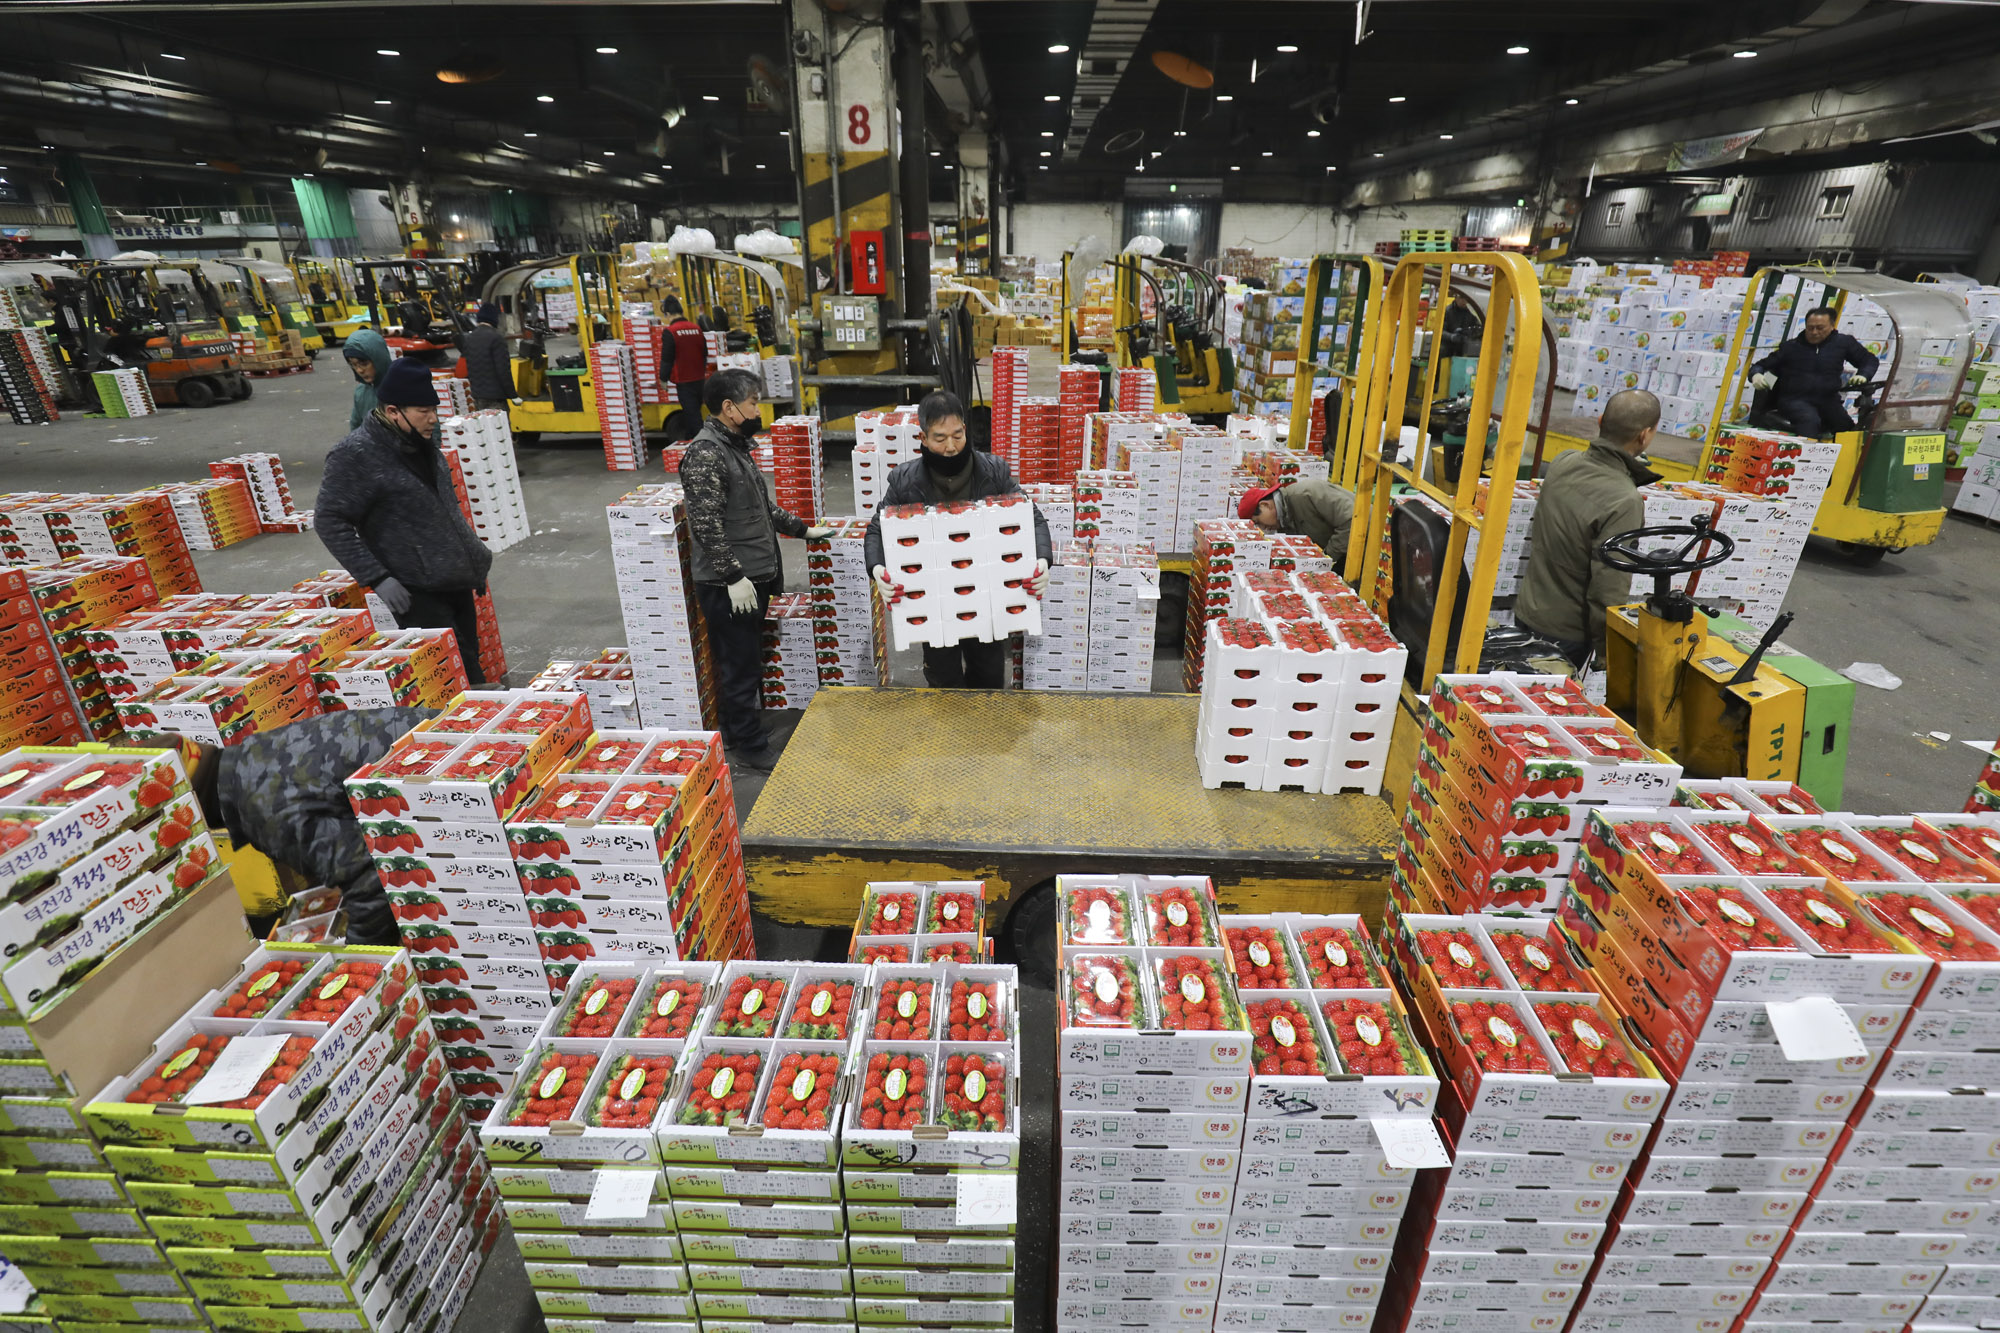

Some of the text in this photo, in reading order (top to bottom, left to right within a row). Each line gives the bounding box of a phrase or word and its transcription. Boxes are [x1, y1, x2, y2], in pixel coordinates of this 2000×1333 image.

[848, 104, 871, 144] 8
[410, 212, 418, 225] 6
[1553, 222, 1566, 234] 12
[203, 344, 233, 354] TOYOTA
[1907, 444, 1941, 455] 한국청과분회
[101, 571, 126, 584] 딸기
[109, 593, 134, 605] 딸기
[339, 625, 358, 638] 딸기
[140, 636, 161, 646] 딸기
[150, 658, 170, 668] 딸기
[269, 672, 290, 687] 딸기
[363, 676, 384, 685] 딸기
[277, 695, 298, 711] 딸기
[184, 710, 208, 721] 딸기
[25, 723, 52, 738] 딸기
[553, 722, 574, 745] 딸기
[1458, 711, 1498, 762] 고맛나루 딸기
[1769, 723, 1784, 761] TPT
[697, 761, 712, 784] 딸기
[1597, 771, 1670, 789] 고맛나루 딸기
[1467, 766, 1487, 796] 딸기
[418, 790, 486, 809] 고맛나루 딸기
[705, 795, 720, 821] 딸기
[1458, 800, 1477, 835] 딸기
[0, 843, 47, 878] 덕천강
[47, 821, 83, 847] 청정
[80, 800, 124, 829] 딸기
[432, 829, 500, 844] 고맛나루 딸기
[580, 835, 650, 851] 고맛나루 딸기
[1449, 835, 1467, 869] 딸기
[444, 864, 510, 879] 고맛나루 딸기
[590, 871, 658, 887] 고맛나루 딸기
[24, 886, 73, 924] 덕천강
[72, 864, 106, 890] 청정
[104, 842, 145, 871] 딸기
[1441, 867, 1458, 902] 딸기
[456, 898, 521, 913] 고맛나루 딸기
[1627, 866, 1688, 943] 고맛나루 딸기
[596, 906, 663, 921] 고맛나루 딸기
[47, 931, 93, 968] 덕천강
[93, 907, 125, 934] 청정
[123, 884, 162, 914] 딸기
[467, 931, 531, 946] 고맛나루 딸기
[1613, 906, 1672, 983] 고맛나루 딸기
[605, 939, 671, 955] 고맛나루 딸기
[477, 964, 539, 978] 고맛나루 딸기
[1890, 972, 1913, 982] 명품
[1600, 943, 1656, 1022] 고맛나루 딸기
[485, 995, 546, 1009] 고맛나루 딸기
[1867, 1016, 1890, 1026] 명품
[1437, 1009, 1456, 1057] 딸기
[288, 1007, 372, 1100] 덕천강 청정 딸기
[1070, 1051, 1098, 1063] 딸기
[1217, 1047, 1238, 1057] 명품
[306, 1041, 386, 1136] 덕천강 청정 딸기
[1069, 1090, 1097, 1101] 딸기
[1212, 1086, 1233, 1095] 명품
[1631, 1095, 1651, 1104] 명품
[1823, 1096, 1844, 1104] 명품
[323, 1075, 398, 1171] 덕천강 청정 딸기
[1210, 1123, 1231, 1132] 명품
[1070, 1128, 1098, 1138] 딸기
[1613, 1133, 1632, 1141] 명품
[342, 1104, 411, 1200] 덕천강 청정 딸기
[1070, 1163, 1096, 1173] 딸기
[1206, 1158, 1226, 1167] 명품
[1595, 1165, 1615, 1174] 명품
[357, 1132, 424, 1229] 덕천강 청정 딸기
[1202, 1191, 1221, 1199] 명품
[1376, 1196, 1395, 1204] 명품
[1197, 1222, 1215, 1230] 명품
[1367, 1227, 1385, 1235] 명품
[385, 1189, 446, 1288] 덕천강 청정 딸기
[422, 1243, 439, 1270] 청정
[437, 1211, 457, 1242] 딸기
[450, 1234, 469, 1265] 딸기
